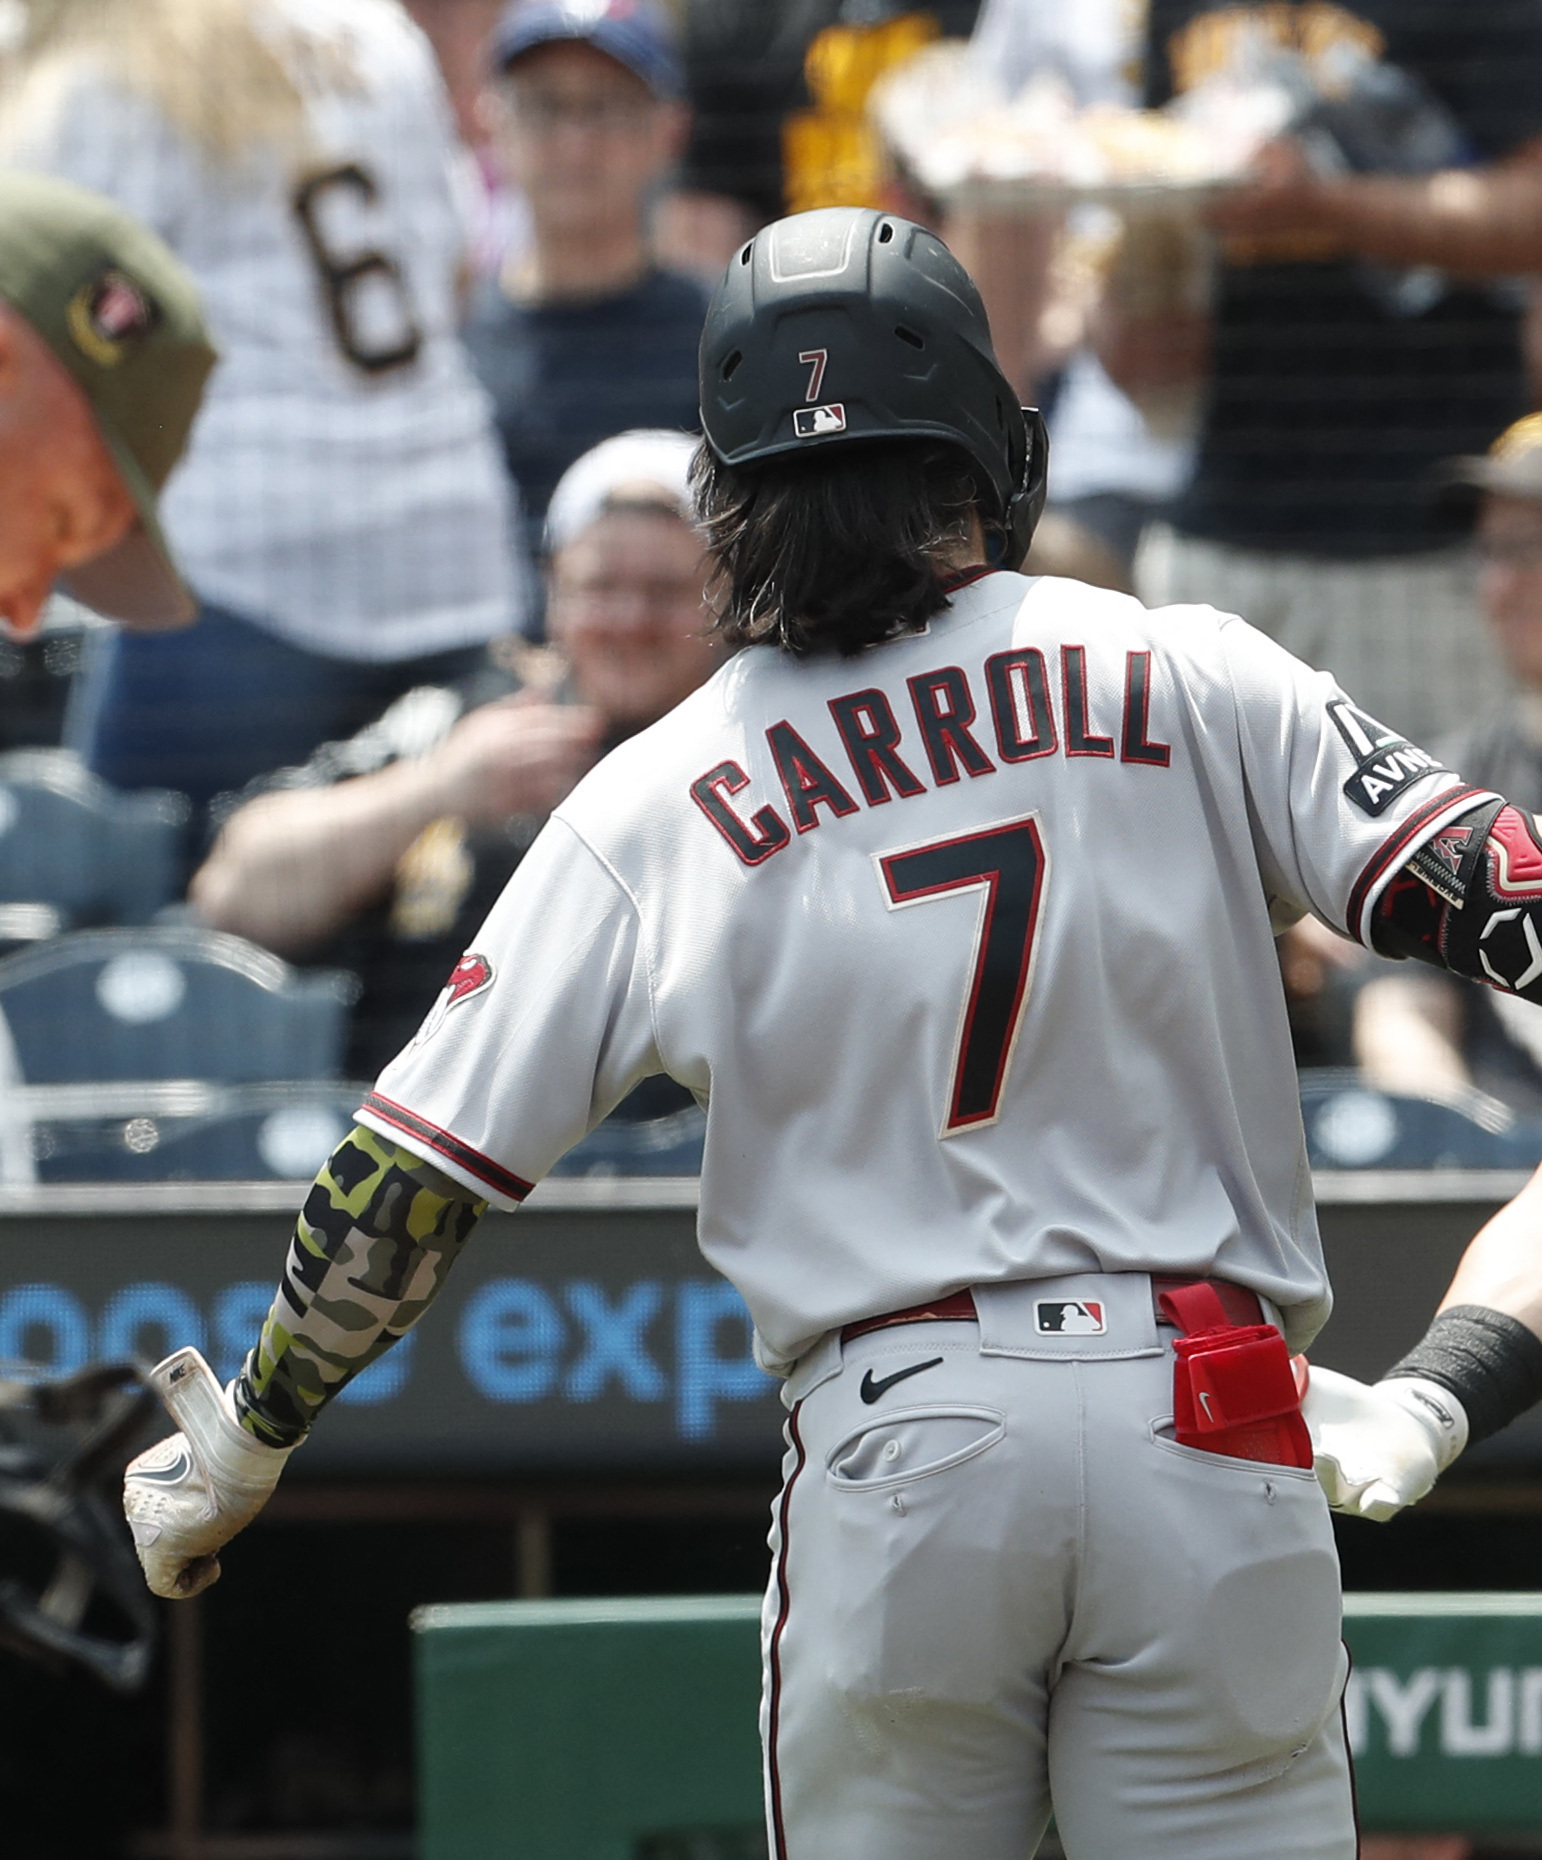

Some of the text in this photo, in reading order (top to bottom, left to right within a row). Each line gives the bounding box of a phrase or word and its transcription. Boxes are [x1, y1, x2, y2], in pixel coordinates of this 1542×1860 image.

[293, 163, 425, 378] 6
[798, 348, 828, 403] 7
[690, 644, 1171, 866] CARROLL
[869, 809, 1052, 1140] 7
